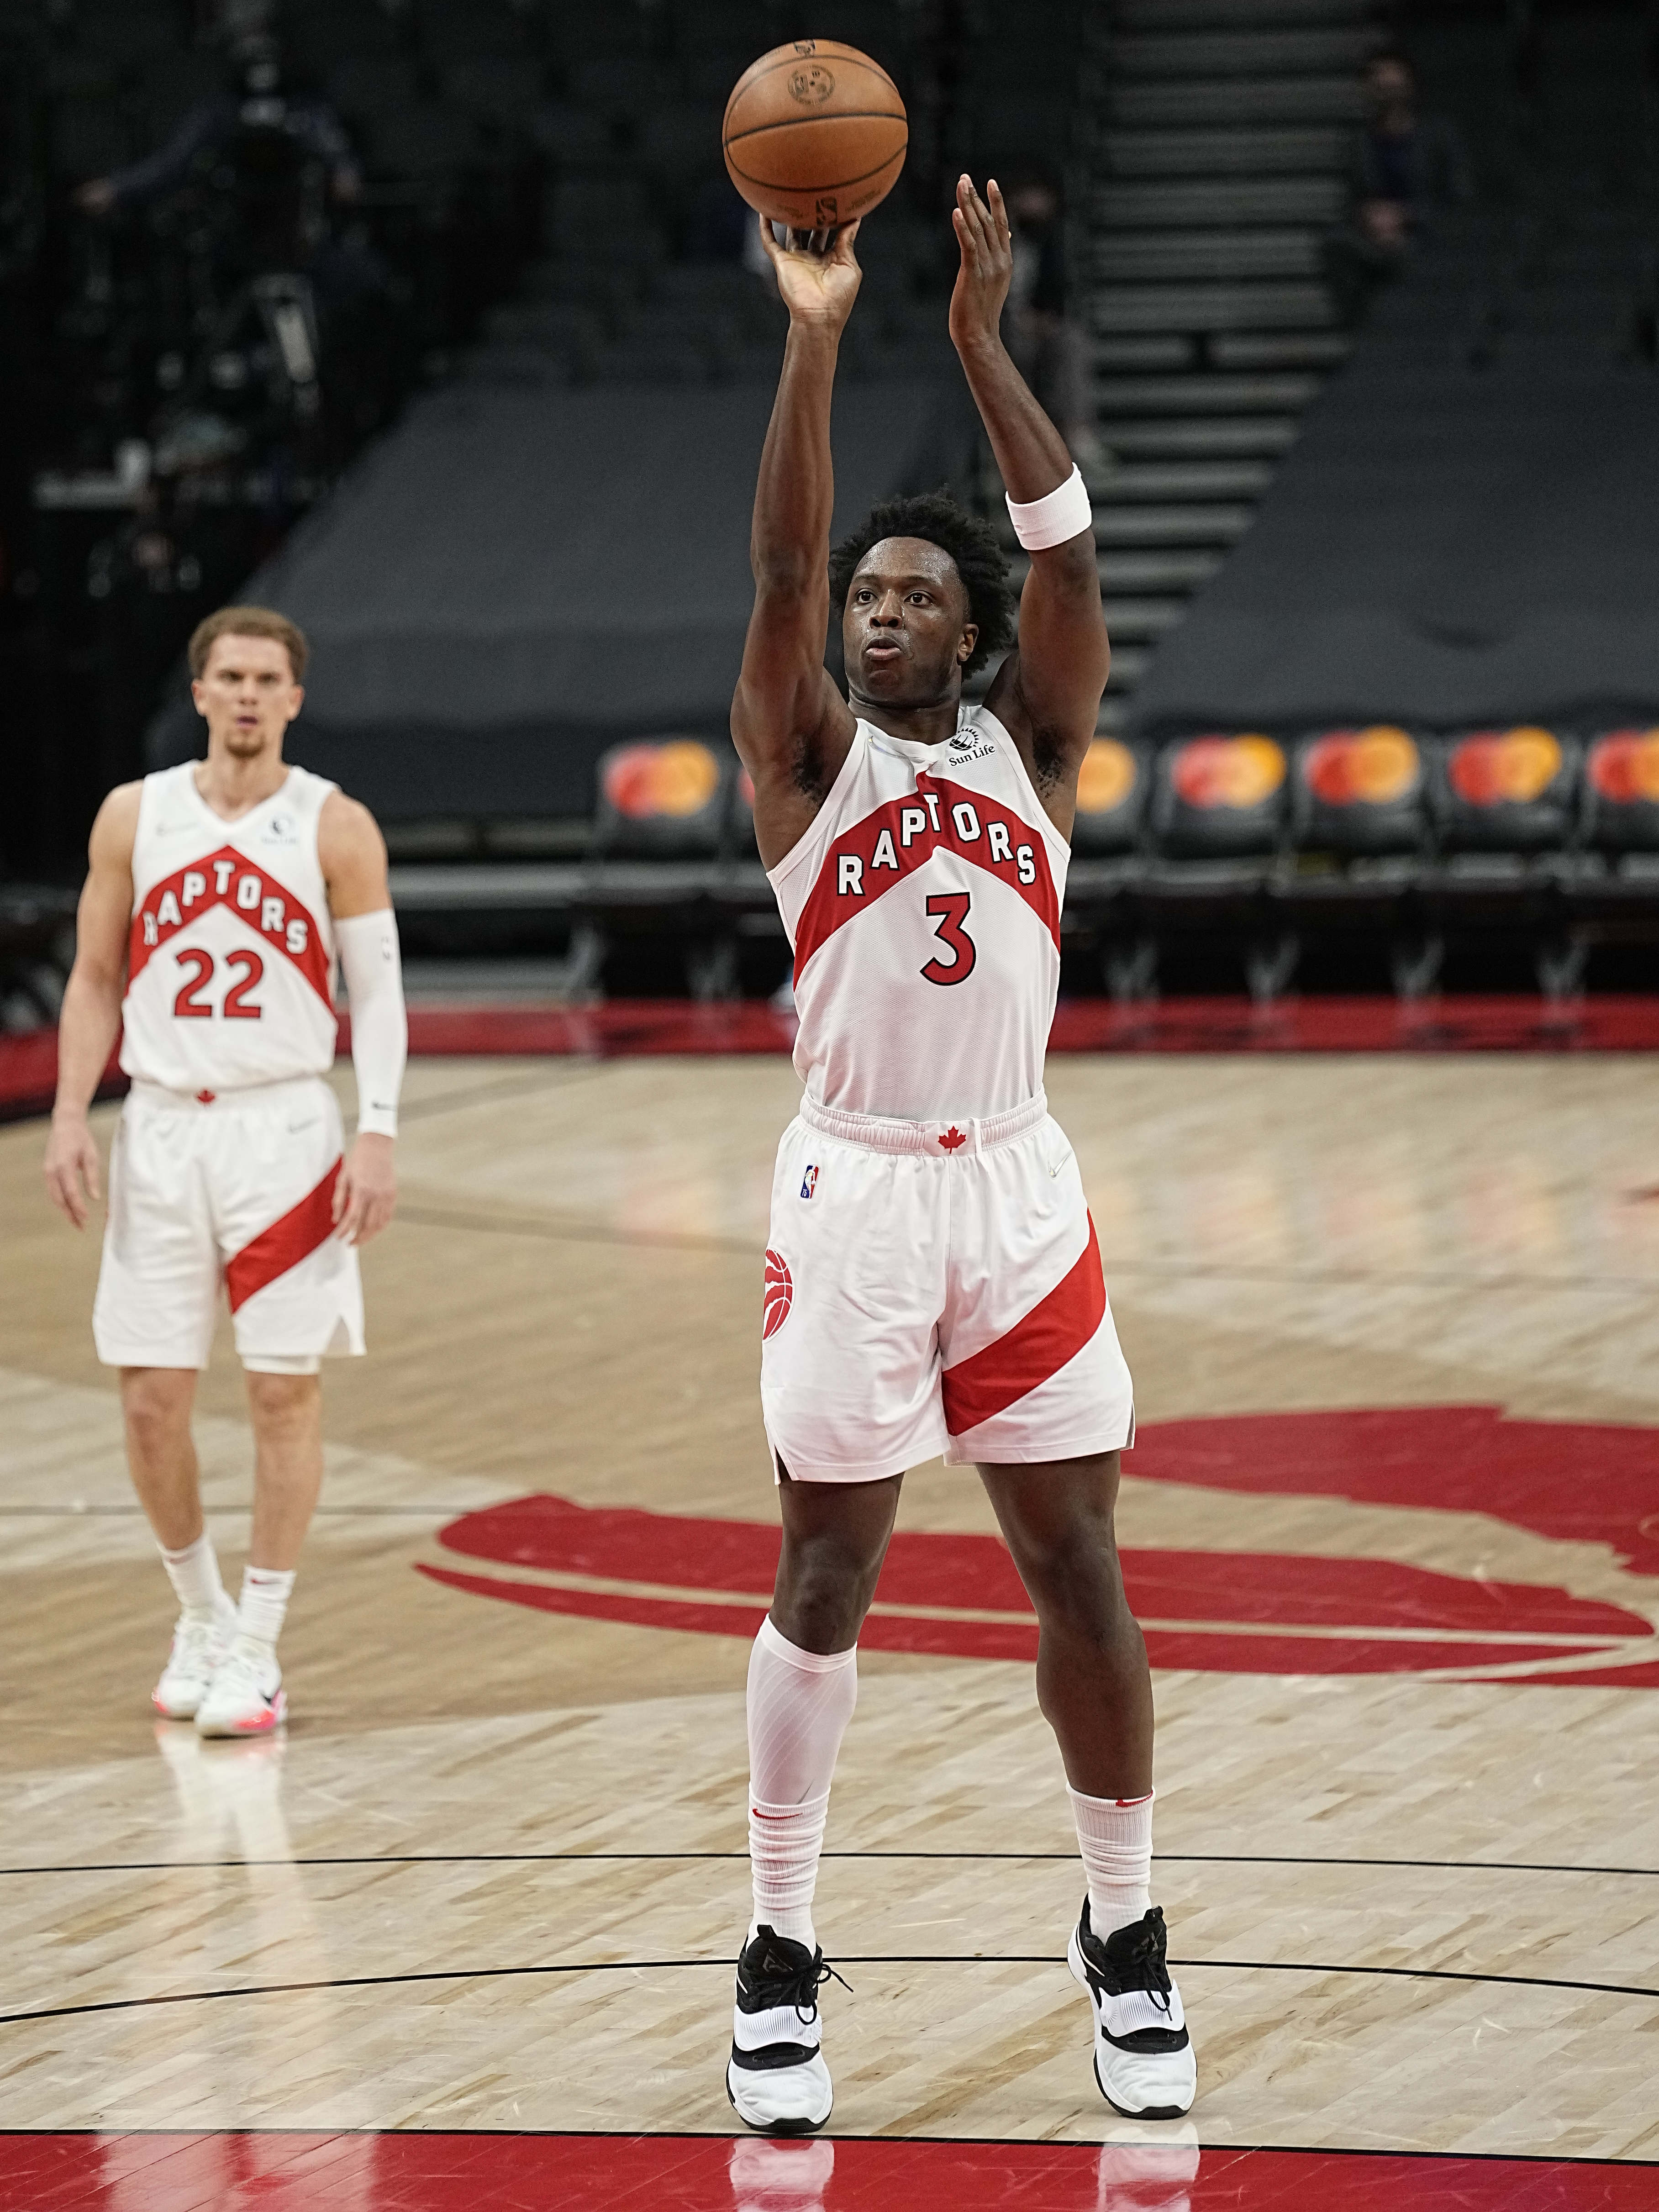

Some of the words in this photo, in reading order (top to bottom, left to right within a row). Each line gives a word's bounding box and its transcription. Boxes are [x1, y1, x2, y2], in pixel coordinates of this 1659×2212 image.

[949, 754, 973, 766] Sun
[972, 745, 995, 758] Life
[837, 793, 1037, 896] RAPTORS
[142, 860, 308, 954] RAPTORS
[920, 892, 976, 986] 3
[174, 948, 263, 1019] 22
[802, 1189, 807, 1197] 75
